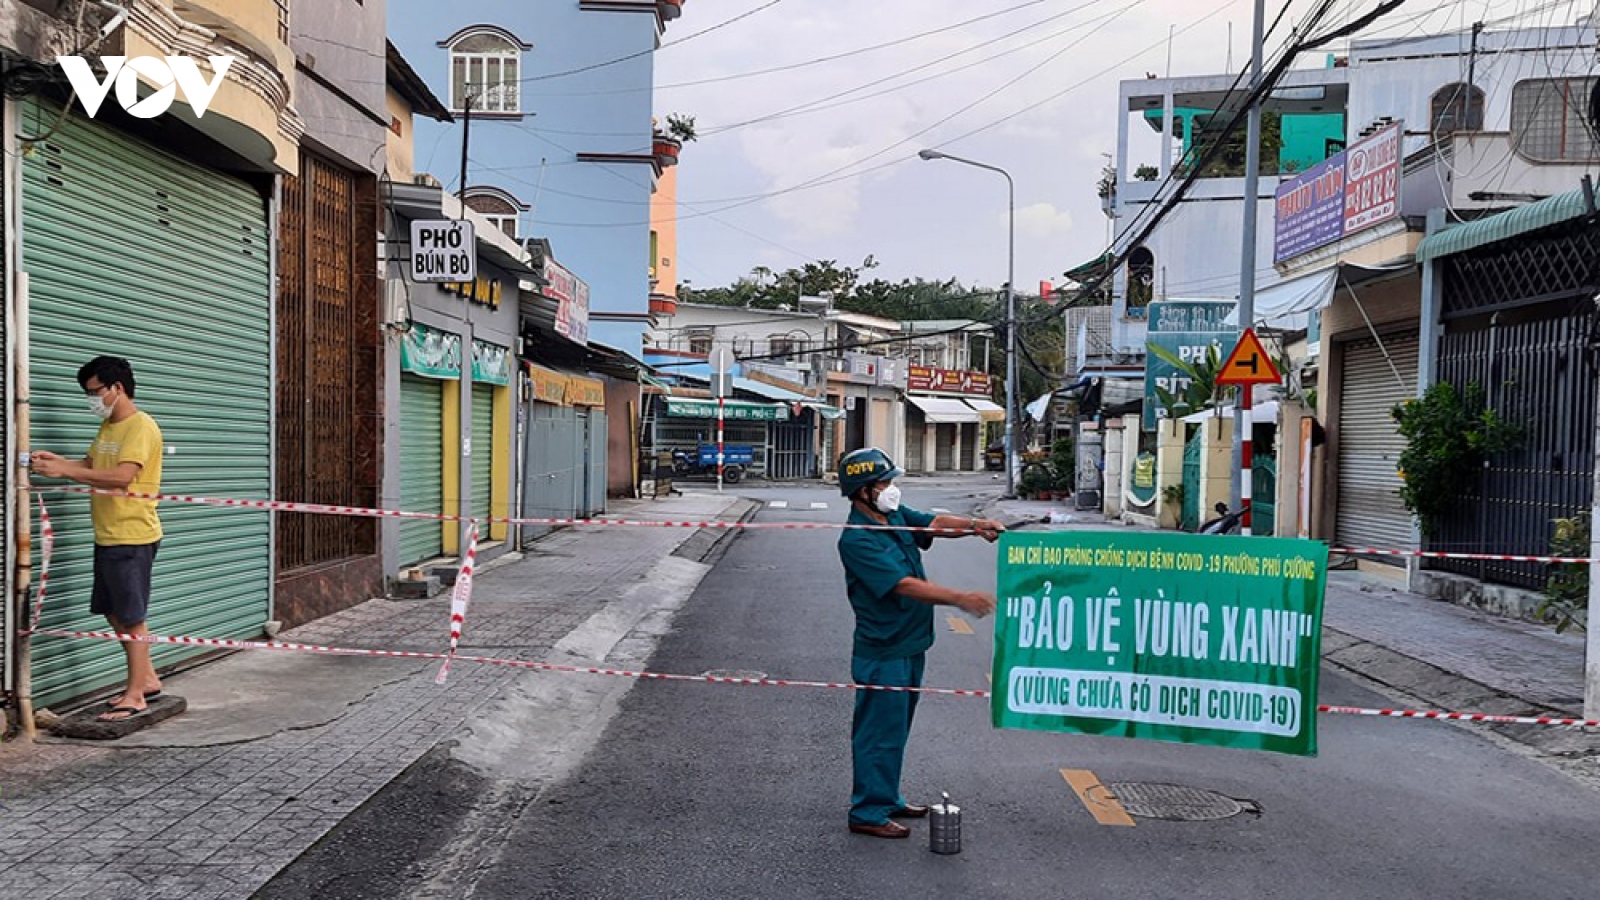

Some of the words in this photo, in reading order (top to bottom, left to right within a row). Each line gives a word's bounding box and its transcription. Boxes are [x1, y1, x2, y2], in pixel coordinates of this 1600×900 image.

[420, 221, 462, 248] PHỞ
[415, 250, 445, 274] BÚN
[450, 250, 470, 274] BÒ
[1008, 546, 1025, 564] BAN
[1027, 541, 1043, 565] CHỈ
[1043, 546, 1062, 568] ĐẠO
[1064, 543, 1093, 566] PHÒNG
[1095, 543, 1125, 567] CHỐNG
[1126, 550, 1148, 572] DỊCH
[1150, 547, 1174, 572] BỆNH
[1177, 552, 1203, 571] COVID
[1222, 551, 1260, 576] PHƯỜNG
[1261, 553, 1281, 577] PHÚ
[1283, 555, 1316, 580] CƯỜNG
[1006, 580, 1075, 650] "BẢO
[1086, 586, 1121, 666] VỆ
[1134, 588, 1209, 660] VÙNG
[1219, 604, 1313, 668] XANH"
[1014, 671, 1070, 706] (VÙNG
[1076, 676, 1123, 709] CHƯA
[1130, 677, 1151, 712] CÓ
[1160, 684, 1200, 720] DỊCH
[1208, 689, 1296, 731] COVID-19)
